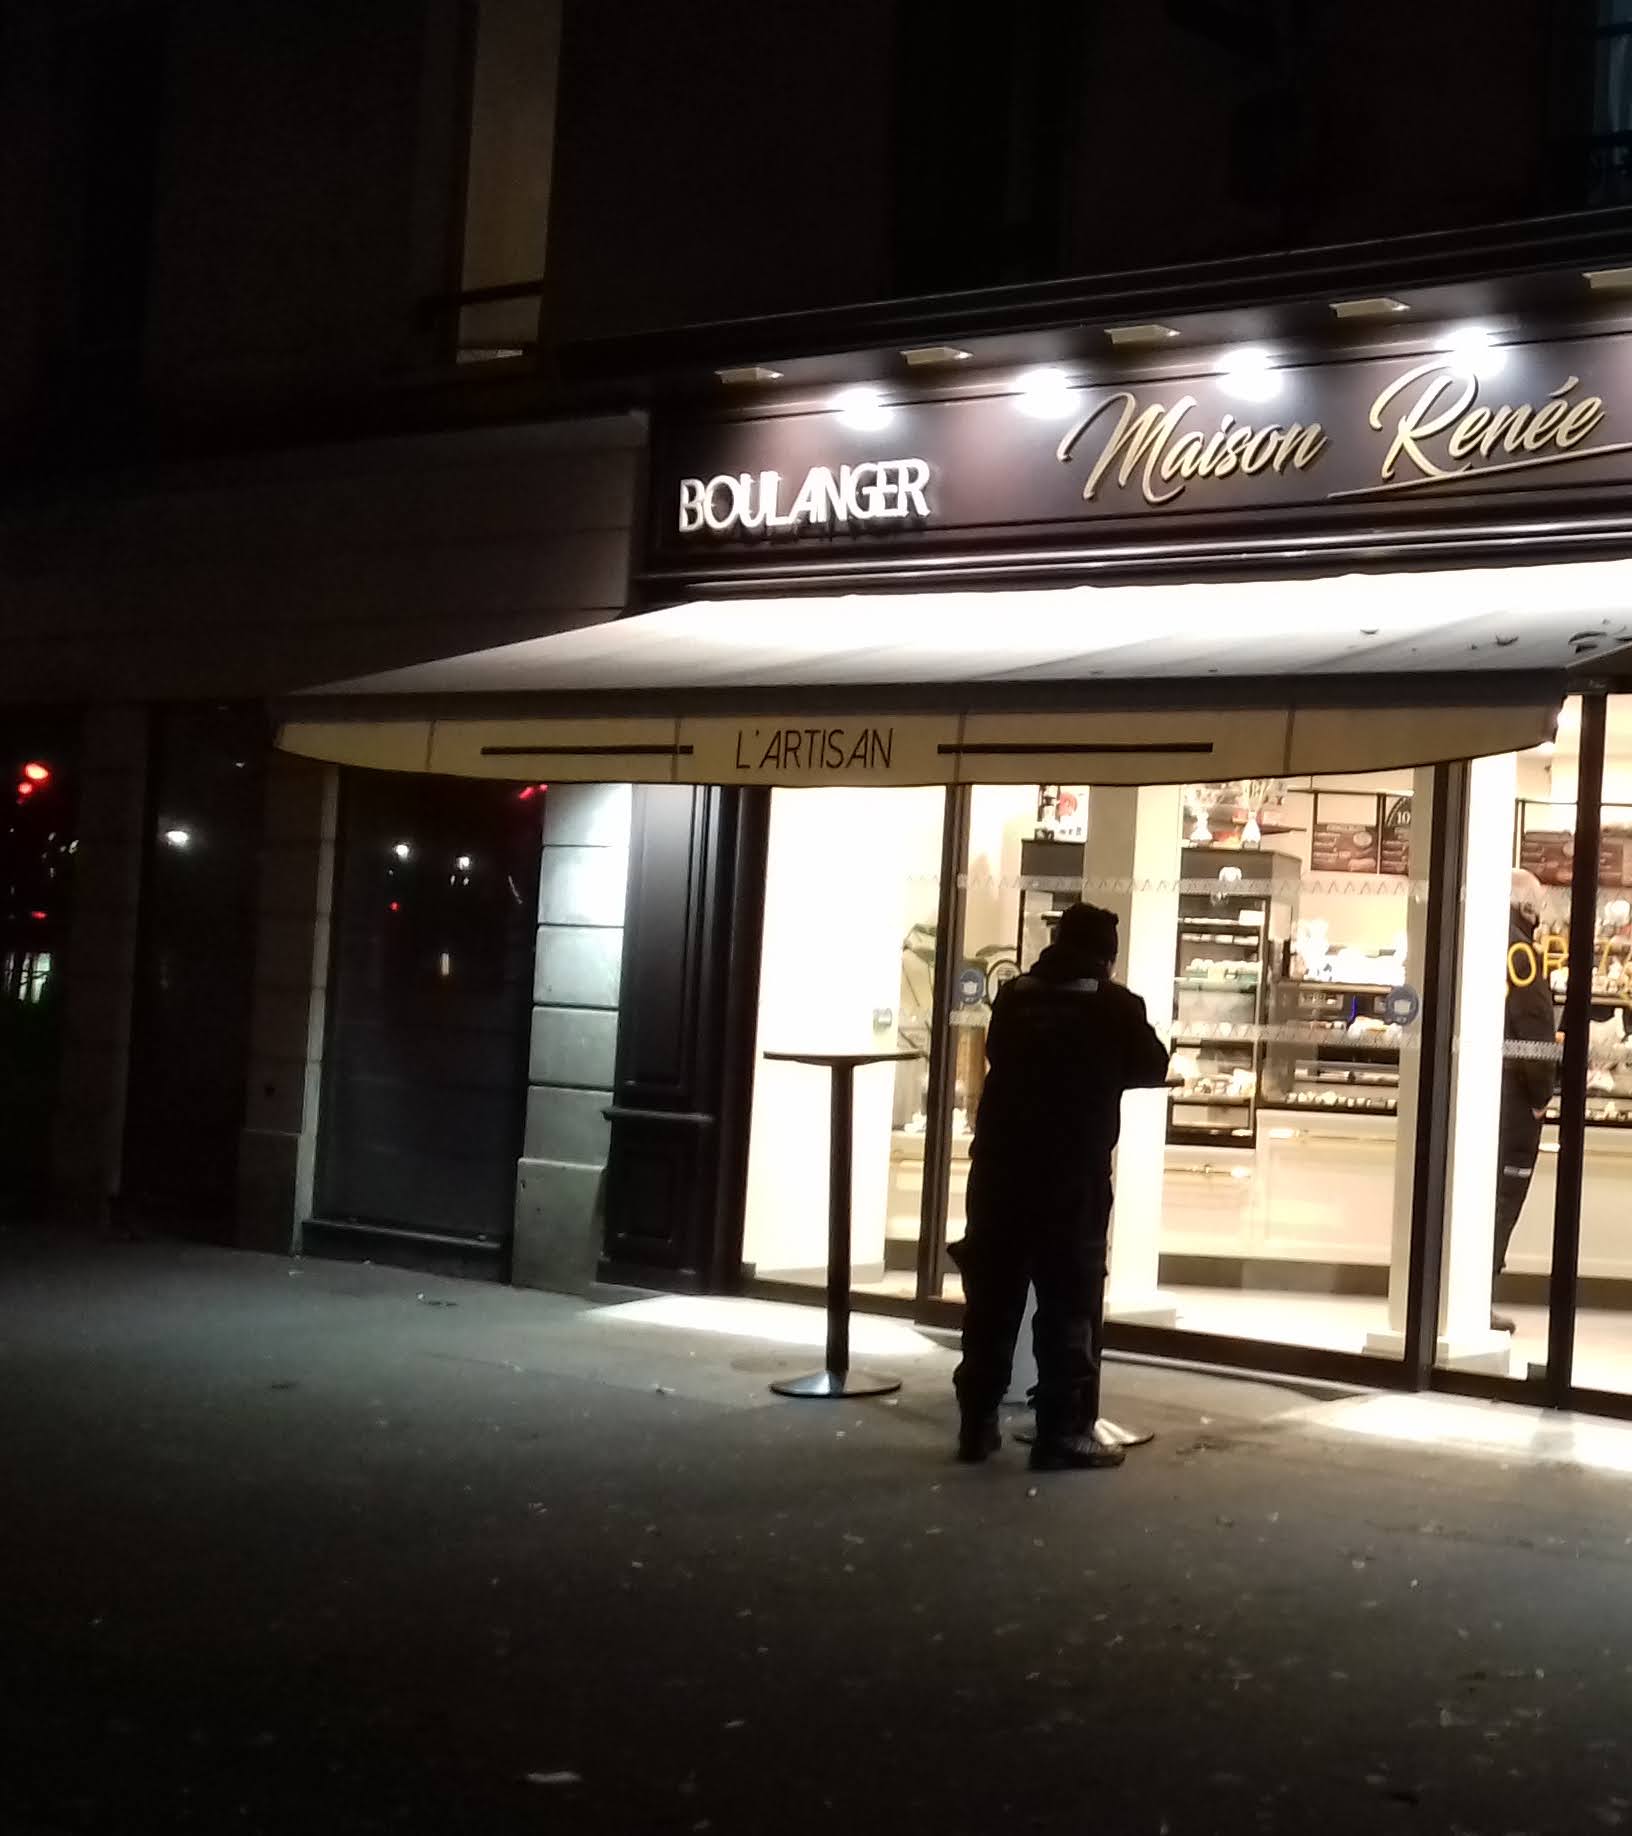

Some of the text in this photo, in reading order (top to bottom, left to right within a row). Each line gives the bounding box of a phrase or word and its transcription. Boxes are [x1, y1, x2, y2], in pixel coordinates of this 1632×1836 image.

[1057, 355, 1605, 502] Maison Renée
[679, 458, 931, 532] BOULANGER
[735, 728, 894, 769] L'ARTISAN
